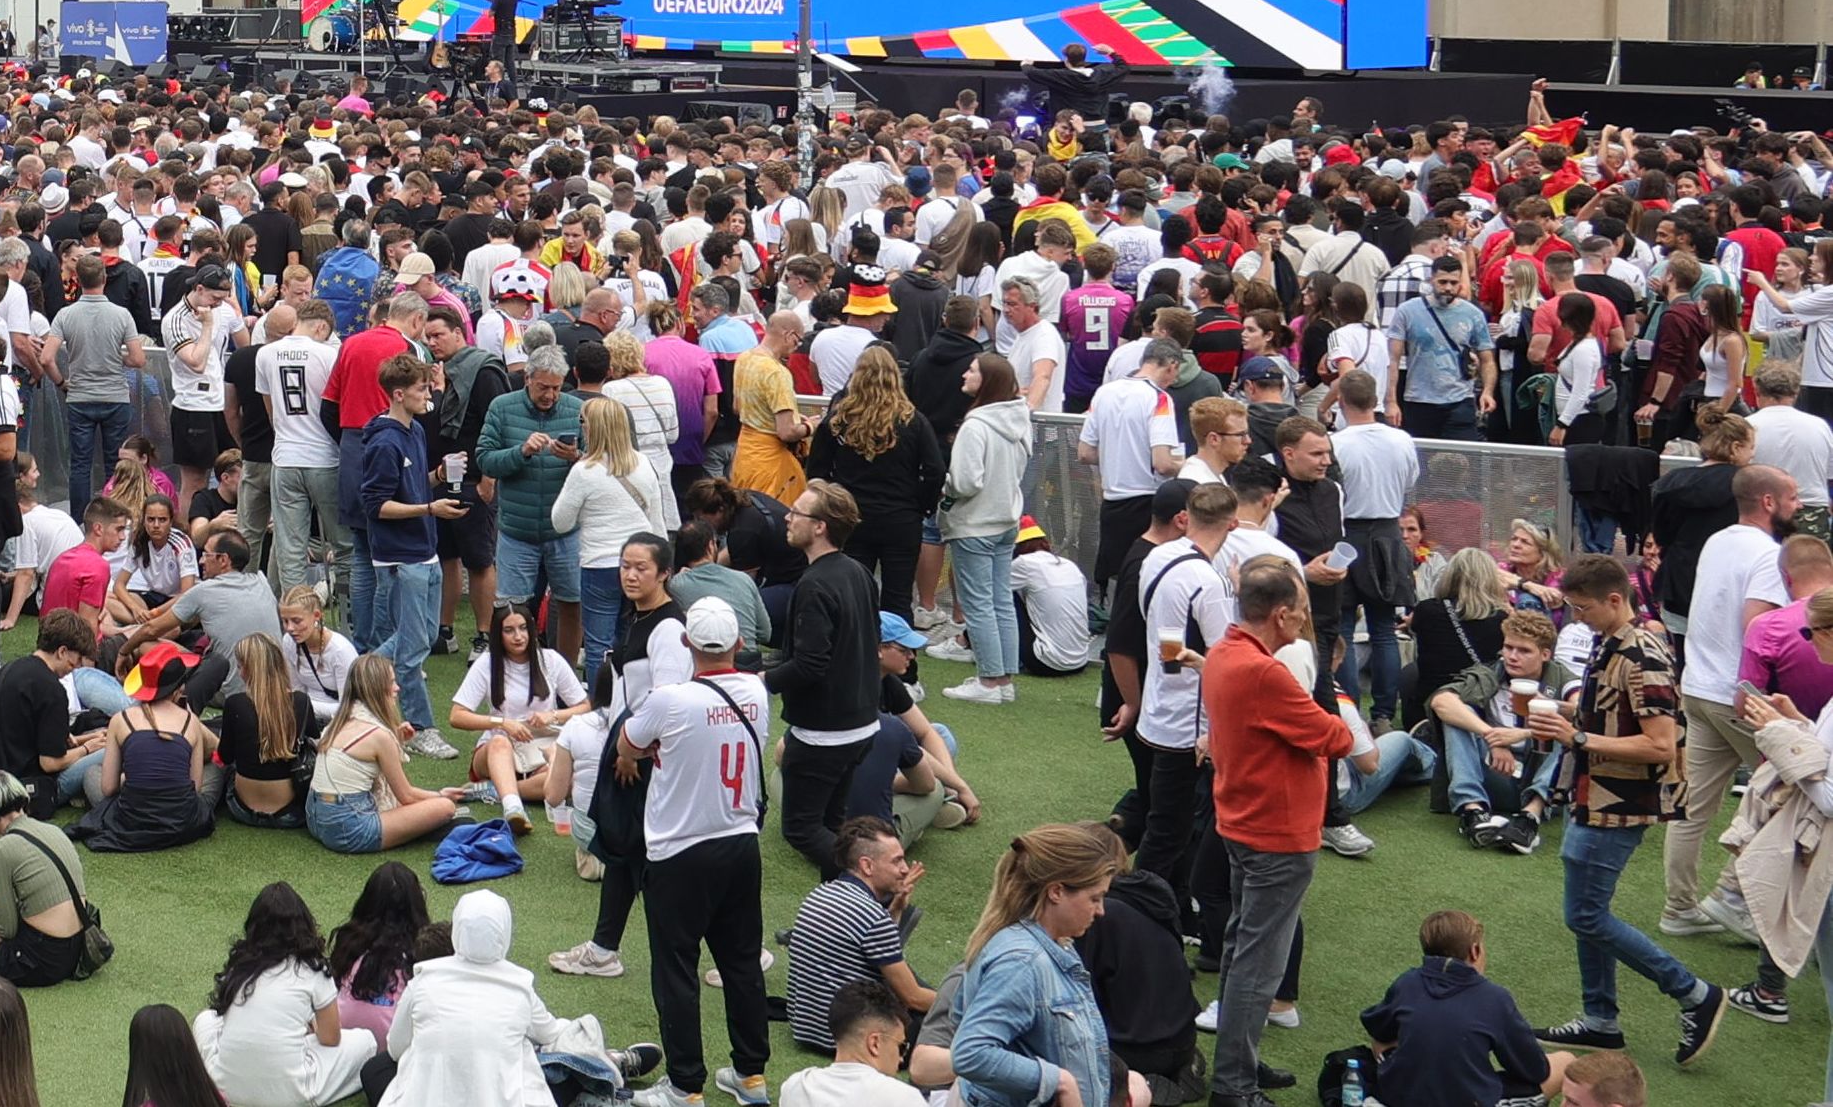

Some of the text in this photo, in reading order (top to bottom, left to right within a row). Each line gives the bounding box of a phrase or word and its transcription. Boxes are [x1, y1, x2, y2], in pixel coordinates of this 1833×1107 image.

[67, 23, 85, 34] vivo
[121, 25, 140, 34] vivo
[1085, 307, 1110, 351] 9
[277, 351, 309, 362] KROOS
[279, 365, 309, 416] 8
[719, 741, 746, 809] 4
